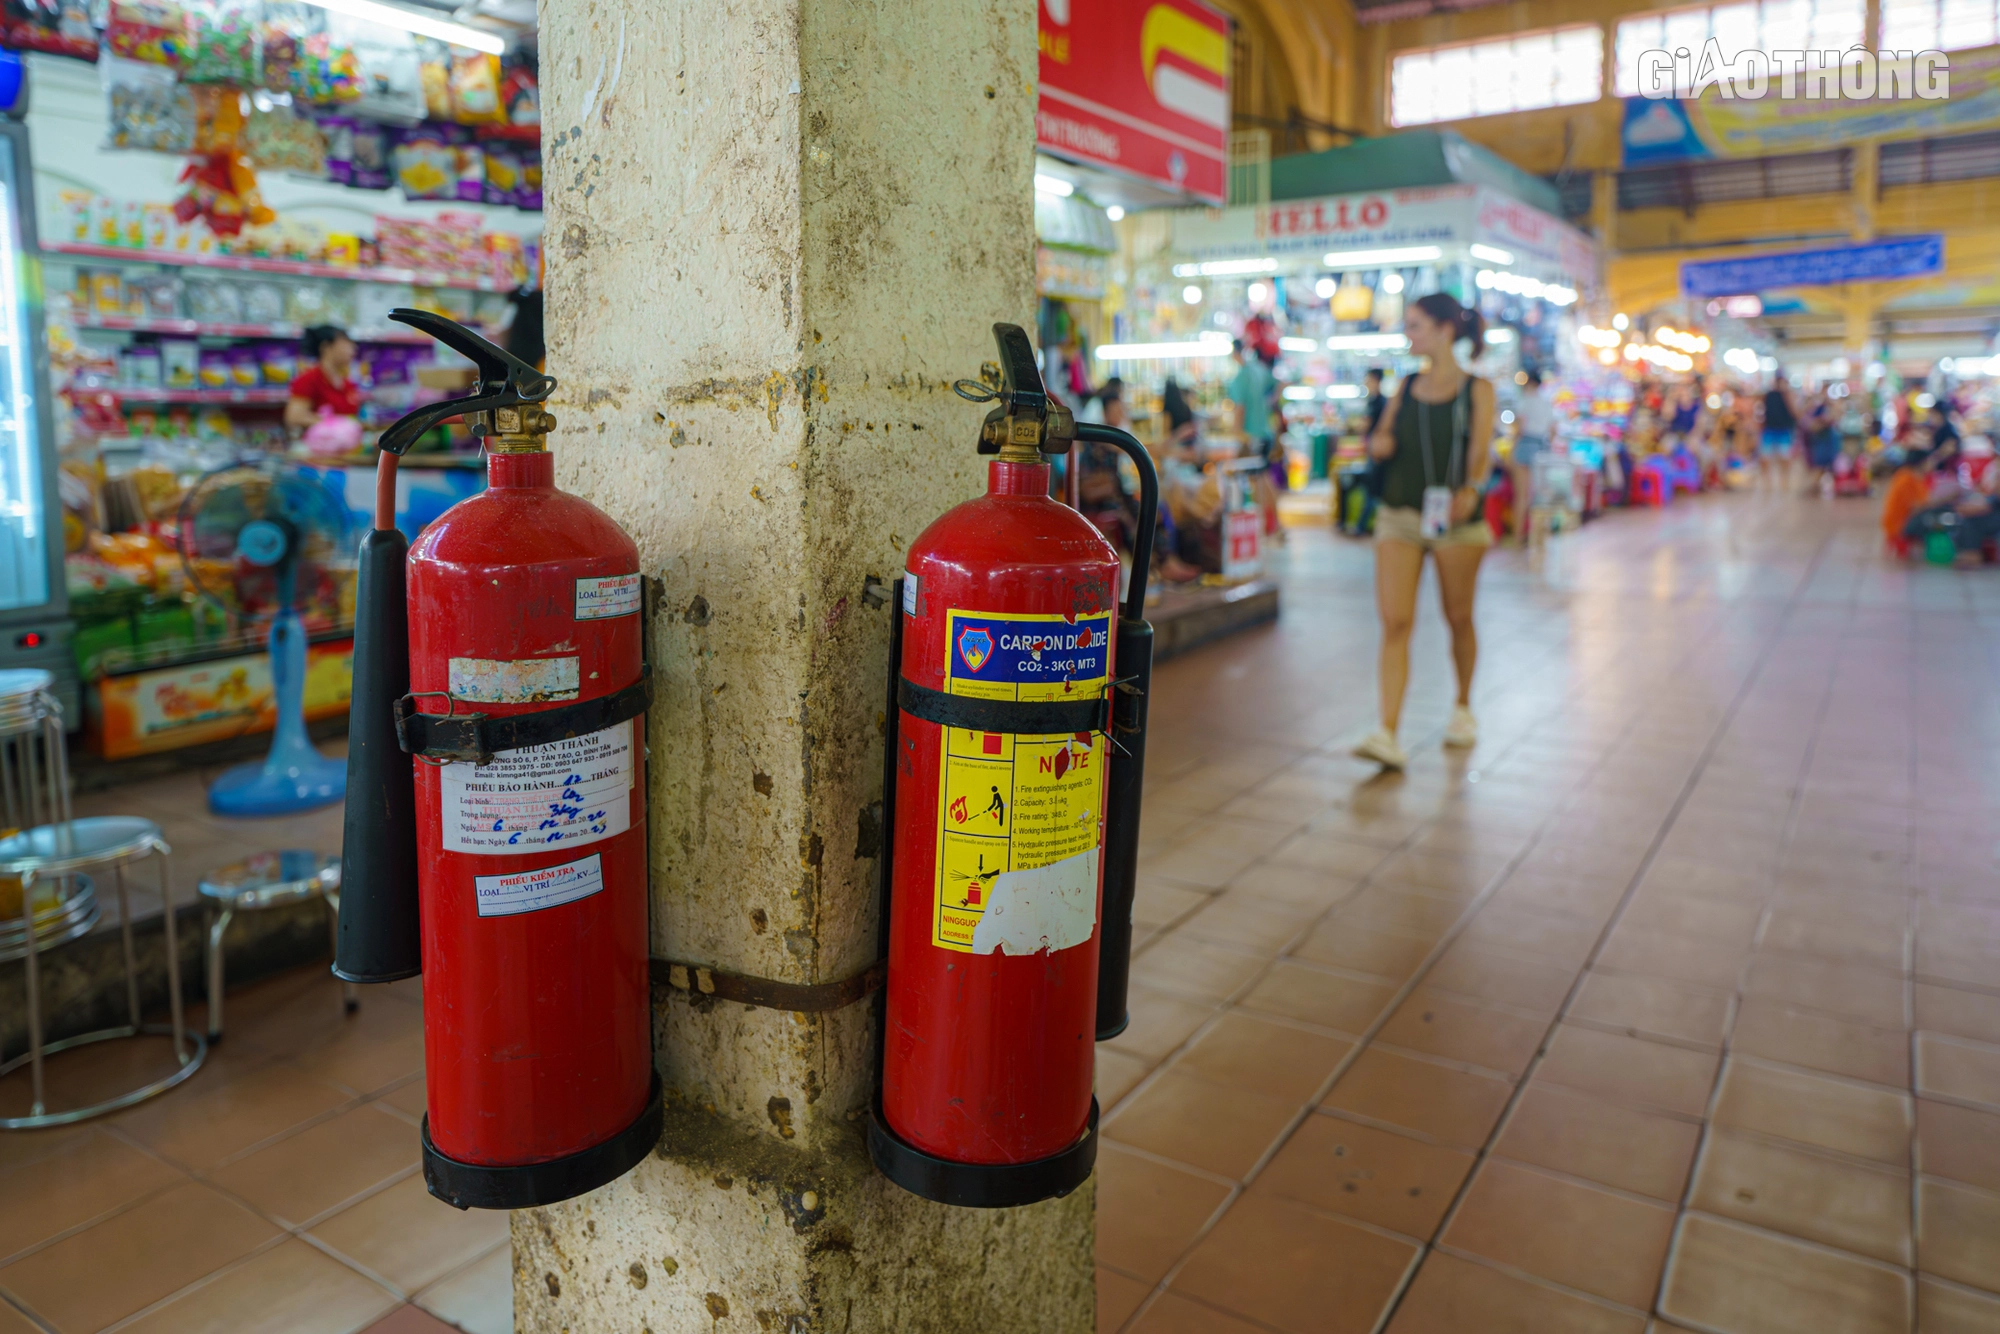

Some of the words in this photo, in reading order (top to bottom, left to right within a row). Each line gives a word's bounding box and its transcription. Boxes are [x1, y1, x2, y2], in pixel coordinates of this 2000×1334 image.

[1017, 660, 1042, 672] CO2
[1077, 657, 1096, 670] MT3
[572, 757, 583, 765] 647
[1039, 751, 1090, 774] NTE
[1021, 785, 1032, 793] Fire
[1033, 783, 1067, 794] extinguishing
[556, 866, 575, 877] TRA
[942, 915, 977, 928] NINGGUO
